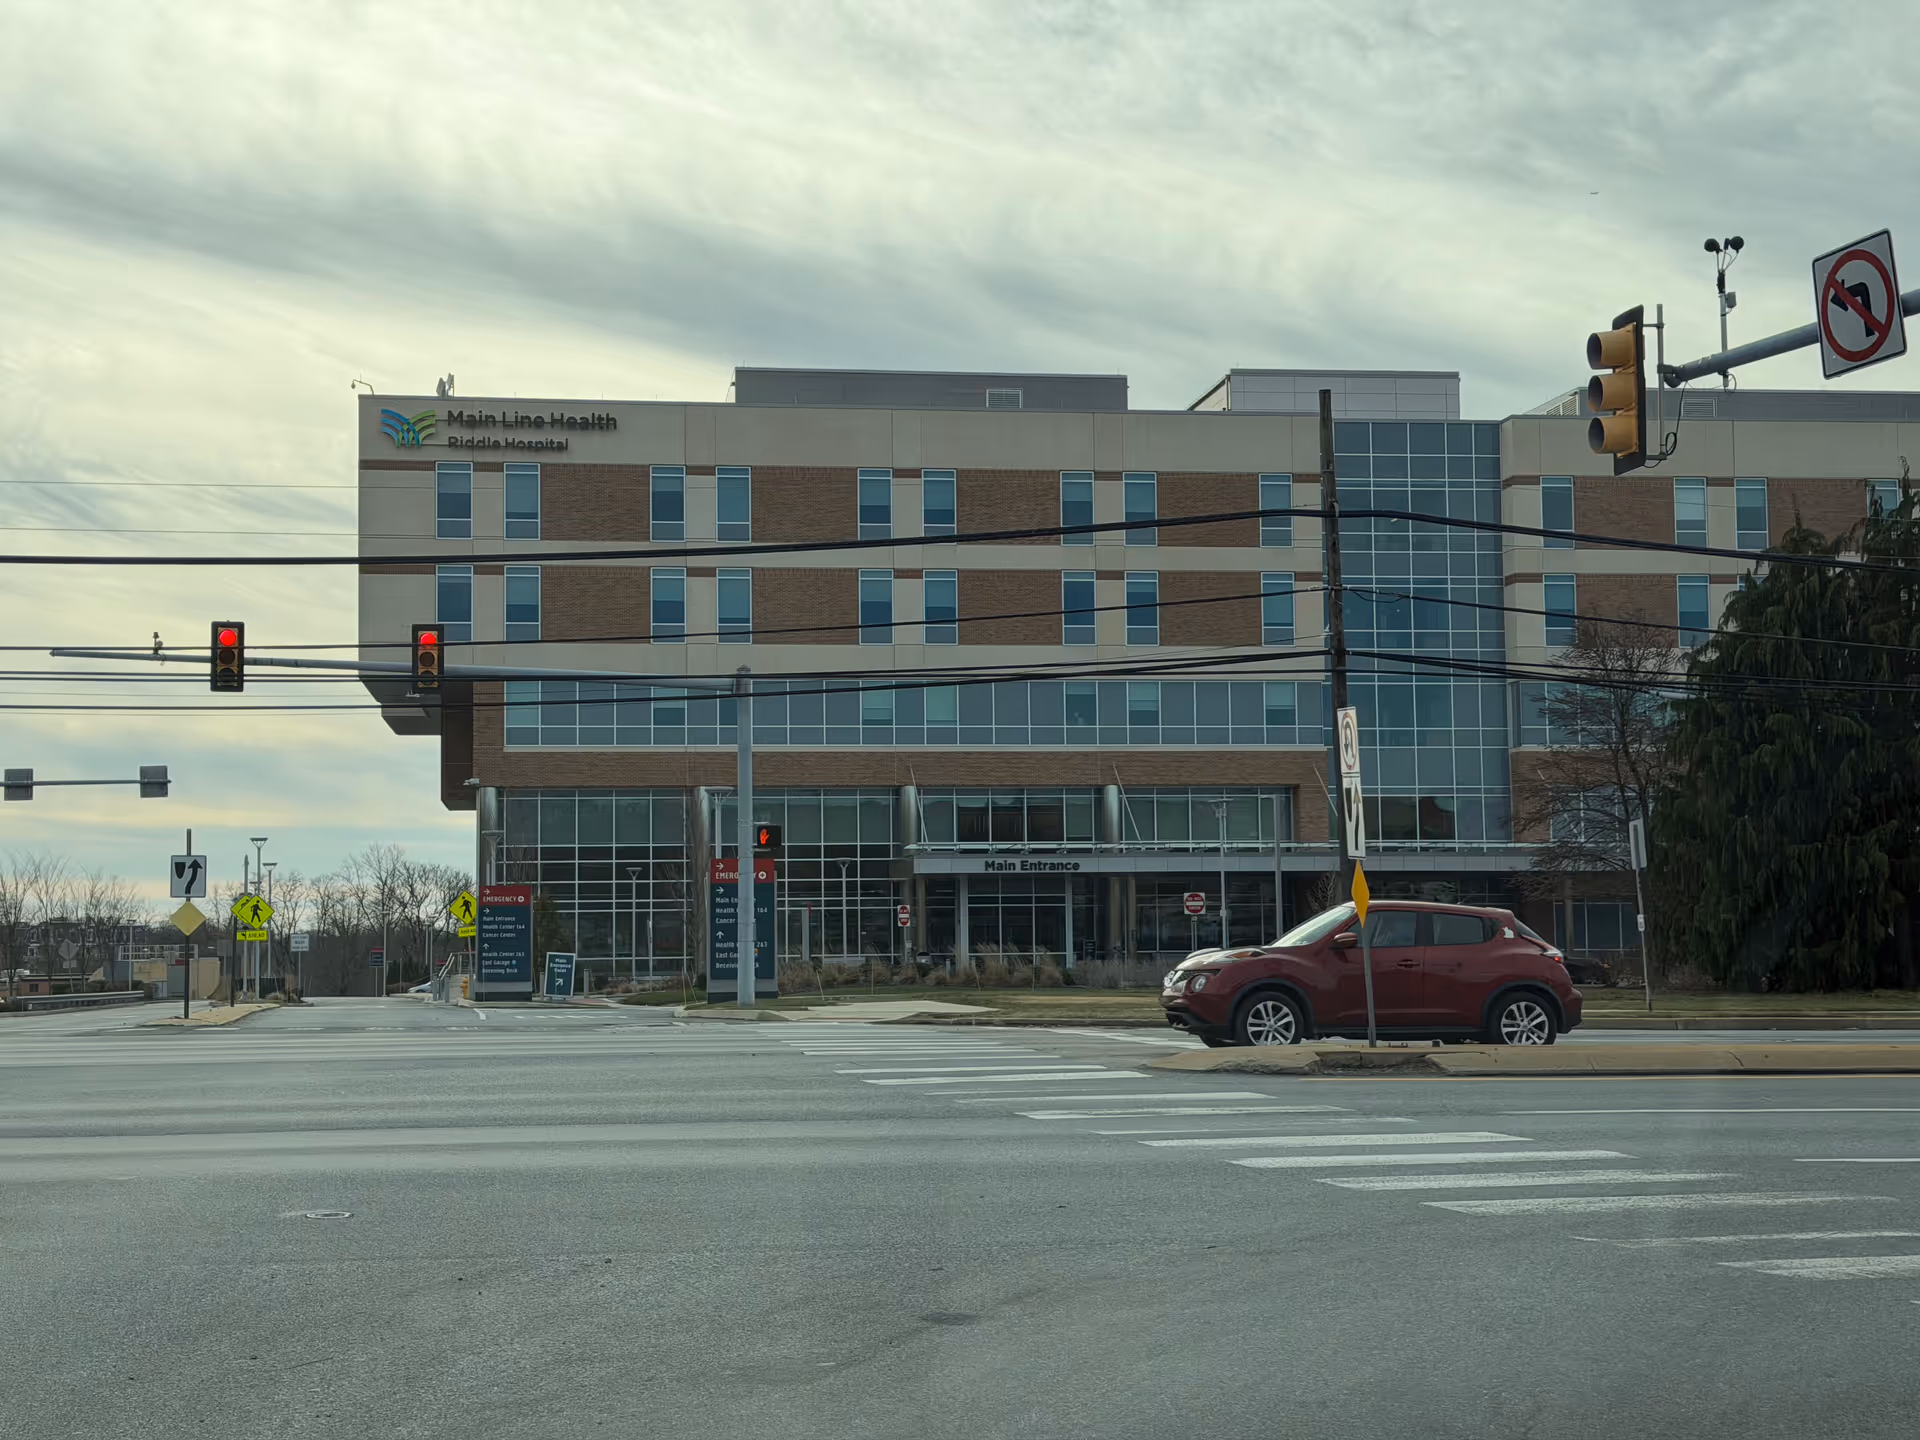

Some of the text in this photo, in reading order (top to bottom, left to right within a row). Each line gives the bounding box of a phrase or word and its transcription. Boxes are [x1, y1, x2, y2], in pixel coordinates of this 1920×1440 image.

[447, 410, 617, 430] Main Line Health
[448, 436, 569, 452] Riddle Hospital
[984, 860, 1080, 871] Main Entrance
